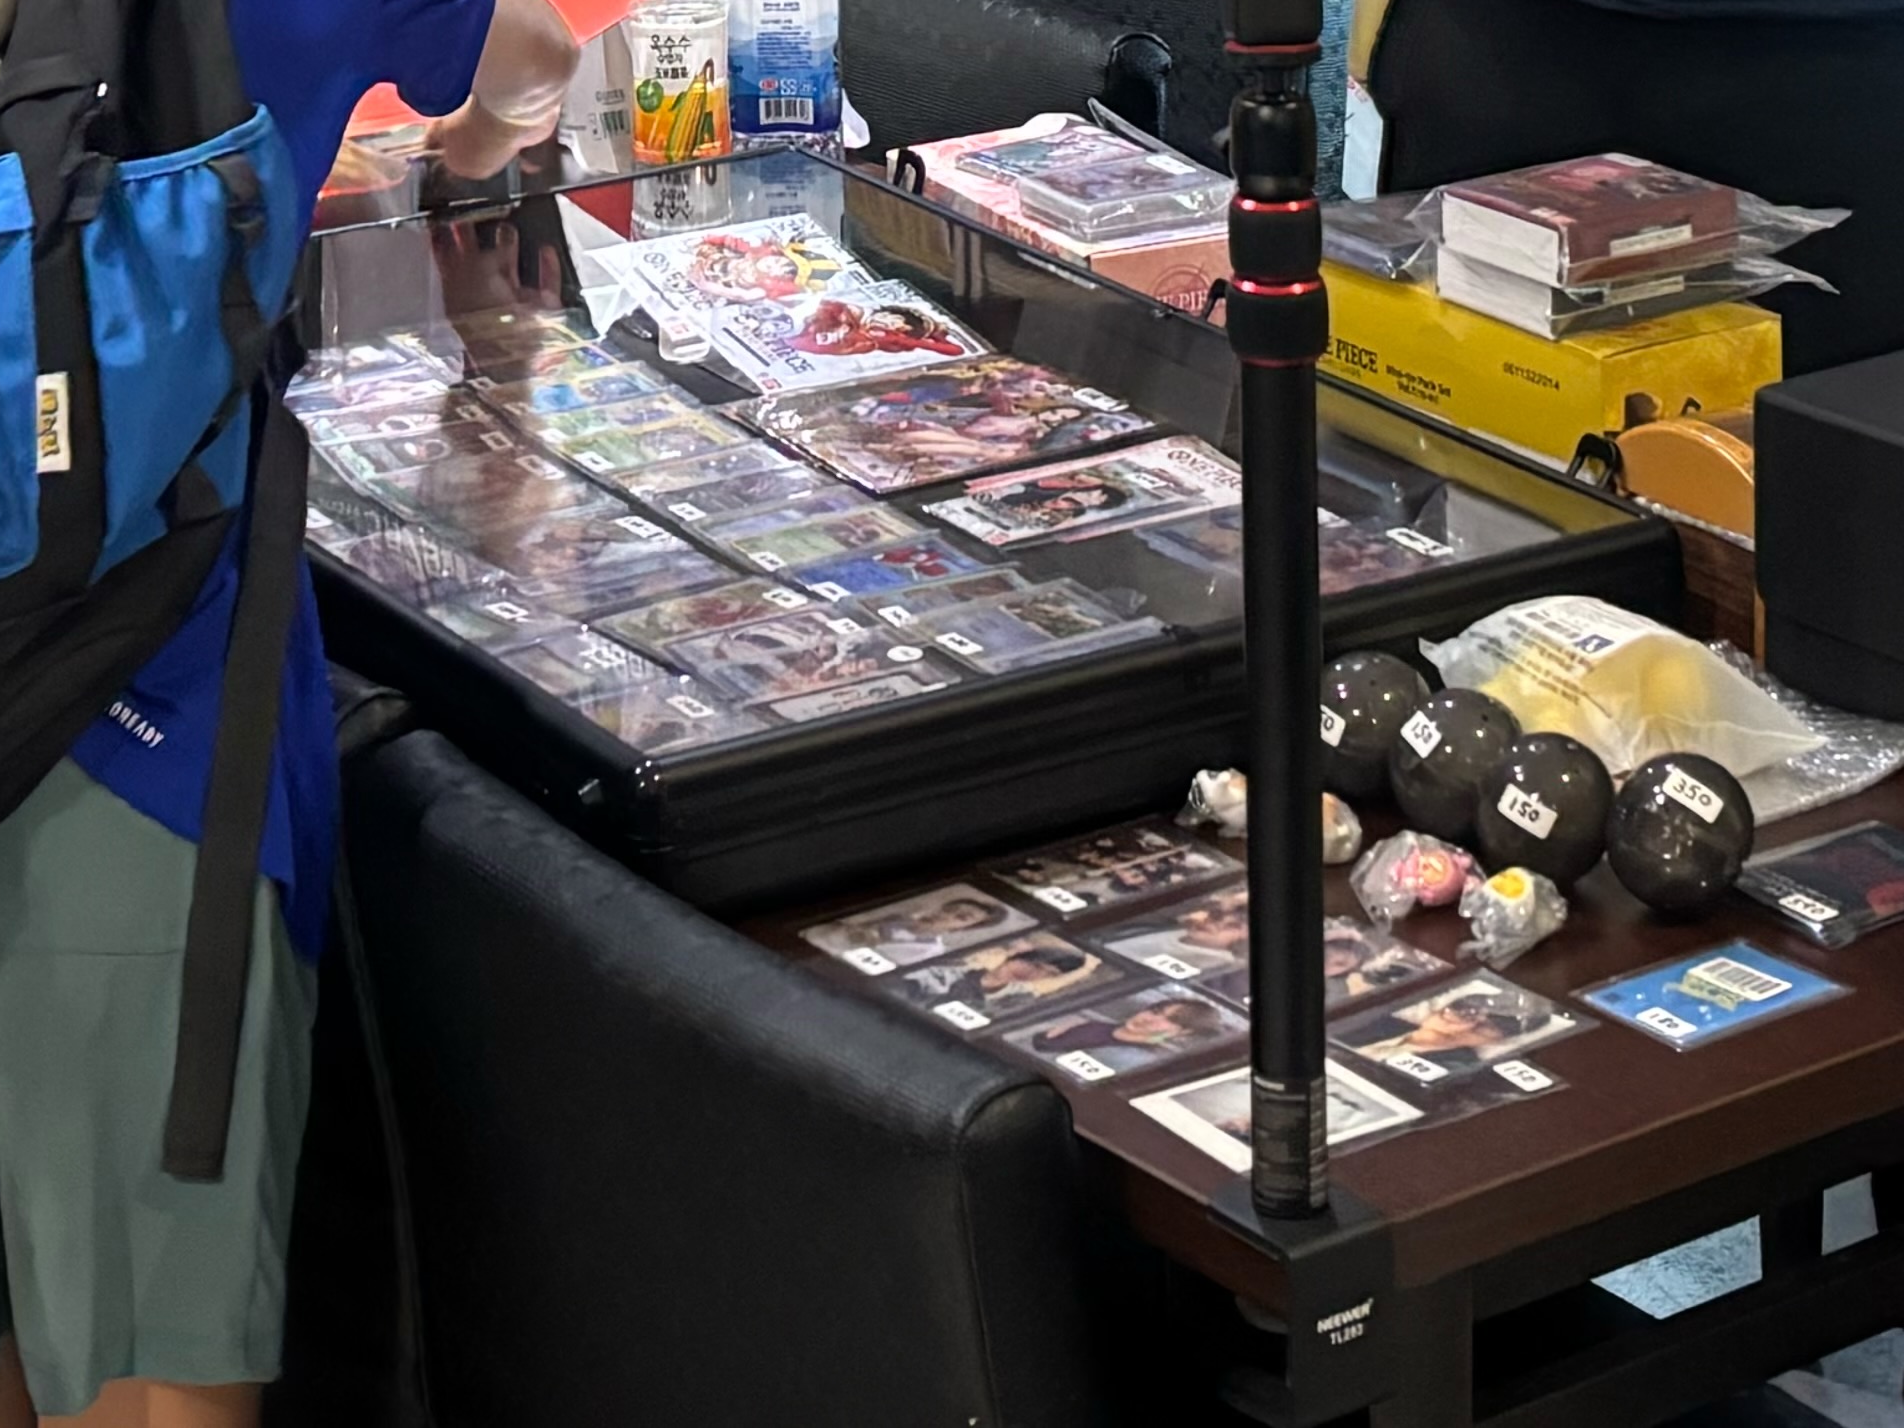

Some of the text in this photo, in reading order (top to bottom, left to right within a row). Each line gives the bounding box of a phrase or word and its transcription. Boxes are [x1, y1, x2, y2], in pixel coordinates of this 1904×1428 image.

[650, 34, 693, 53] 옥수수
[1336, 337, 1379, 374] PIECE
[1410, 722, 1435, 745] 150
[1672, 777, 1714, 809] 350
[1507, 795, 1542, 824] 150
